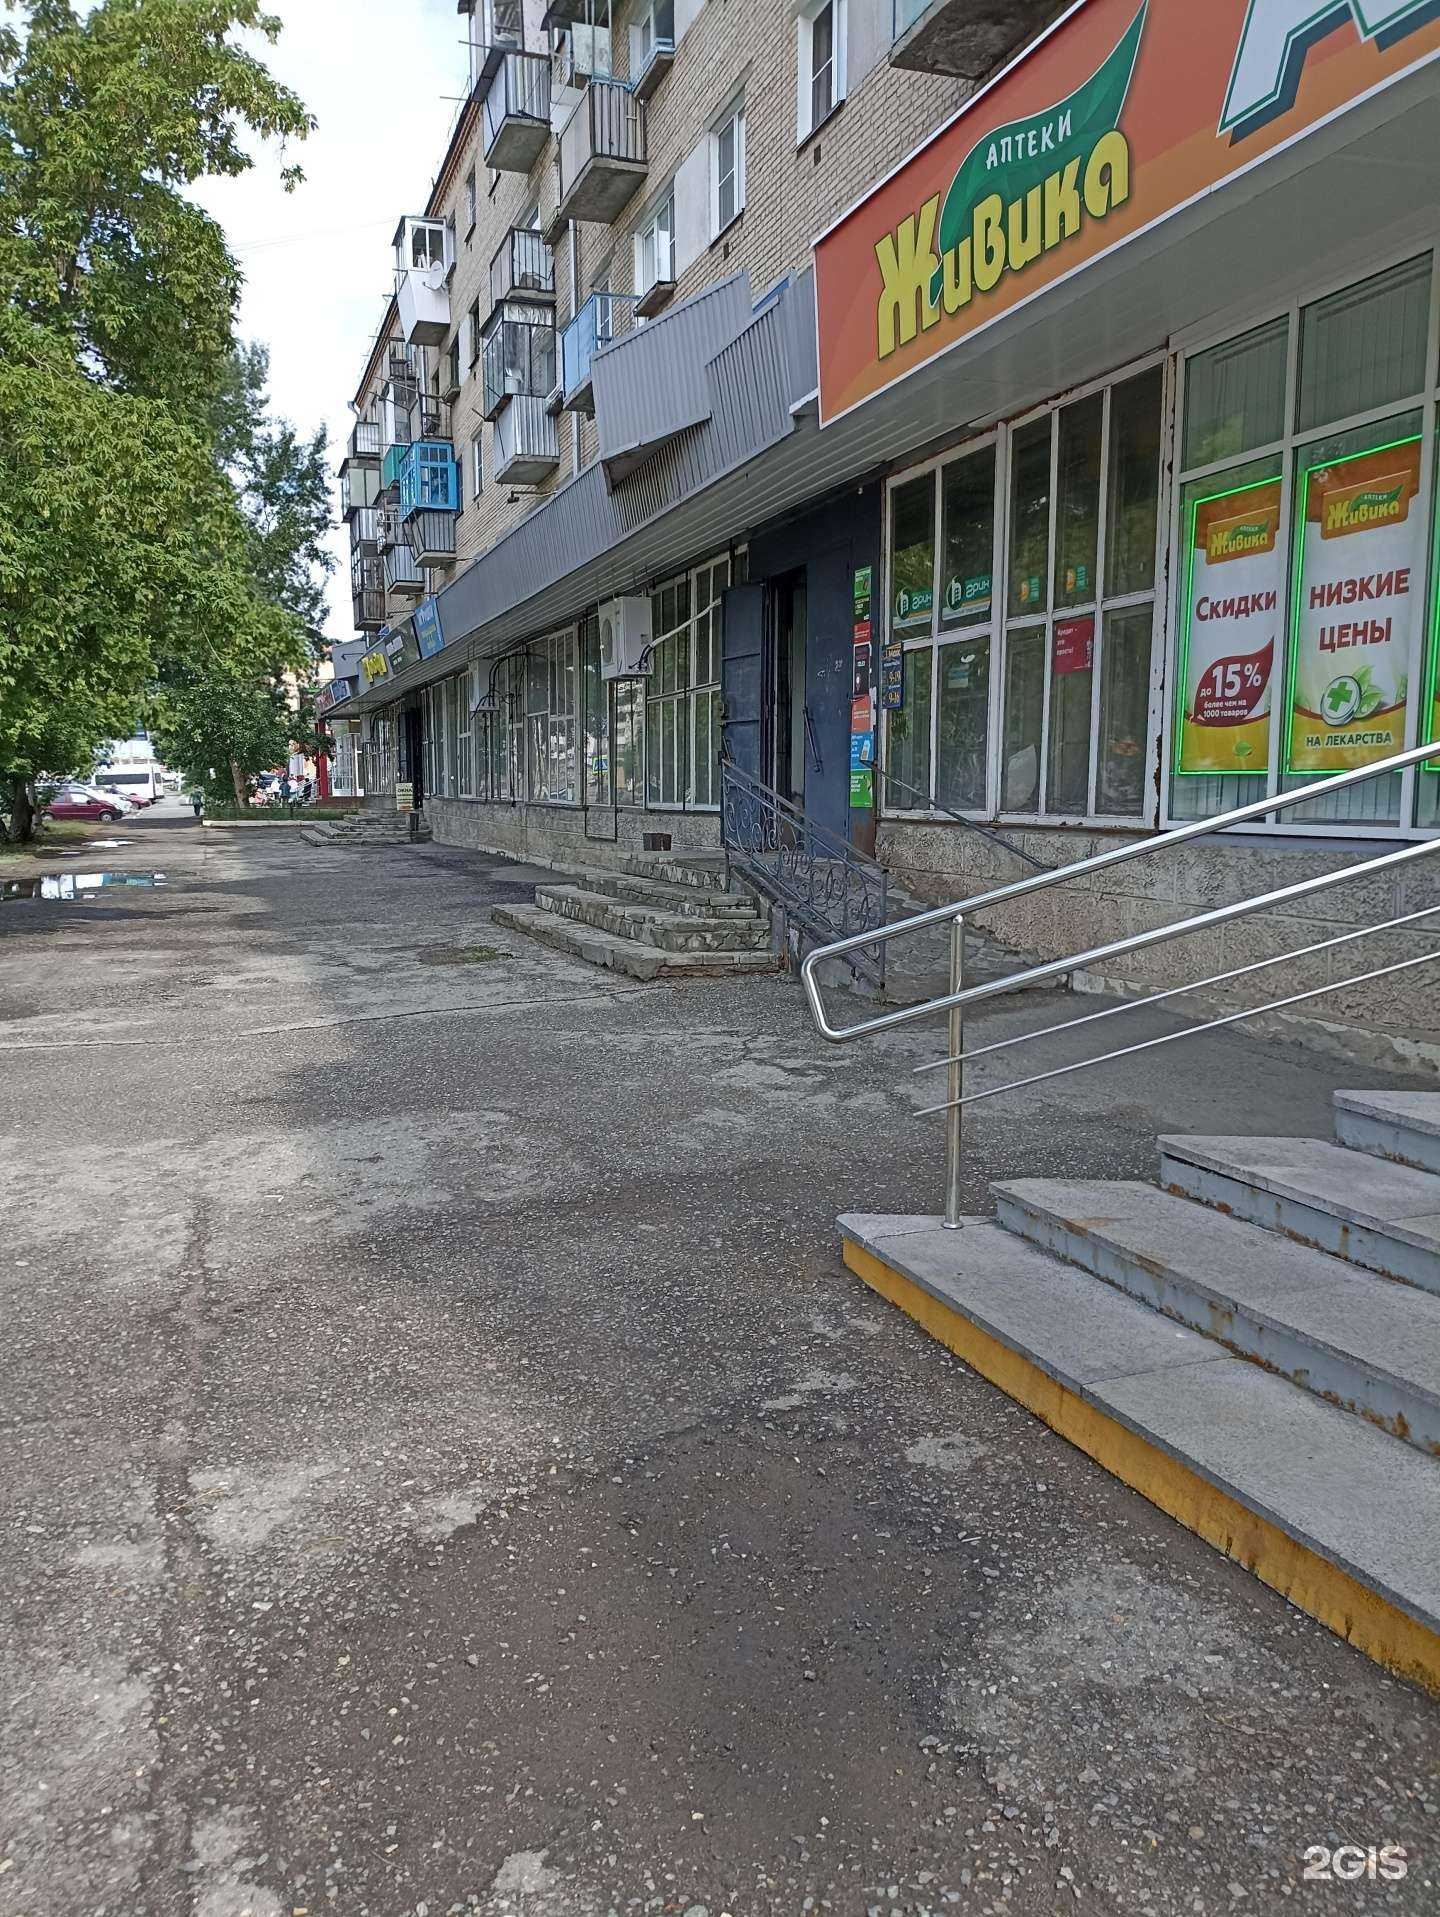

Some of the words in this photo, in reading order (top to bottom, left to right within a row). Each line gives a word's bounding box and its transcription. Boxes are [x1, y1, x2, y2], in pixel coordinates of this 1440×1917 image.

[985, 109, 1072, 170] АПТЕКИ
[875, 131, 1130, 361] Живика
[1327, 500, 1399, 529] Живика
[1211, 532, 1268, 557] Живика
[1309, 568, 1410, 609] НИЗКИЕ
[1319, 618, 1392, 653] ЦЕНЫ
[1200, 688, 1212, 697] до
[1212, 662, 1262, 698] 15%
[1204, 709, 1220, 717] 1000
[1220, 709, 1248, 717] товаров
[1306, 736, 1321, 747] НА
[1326, 732, 1392, 746] ЛЕКАРСТВА
